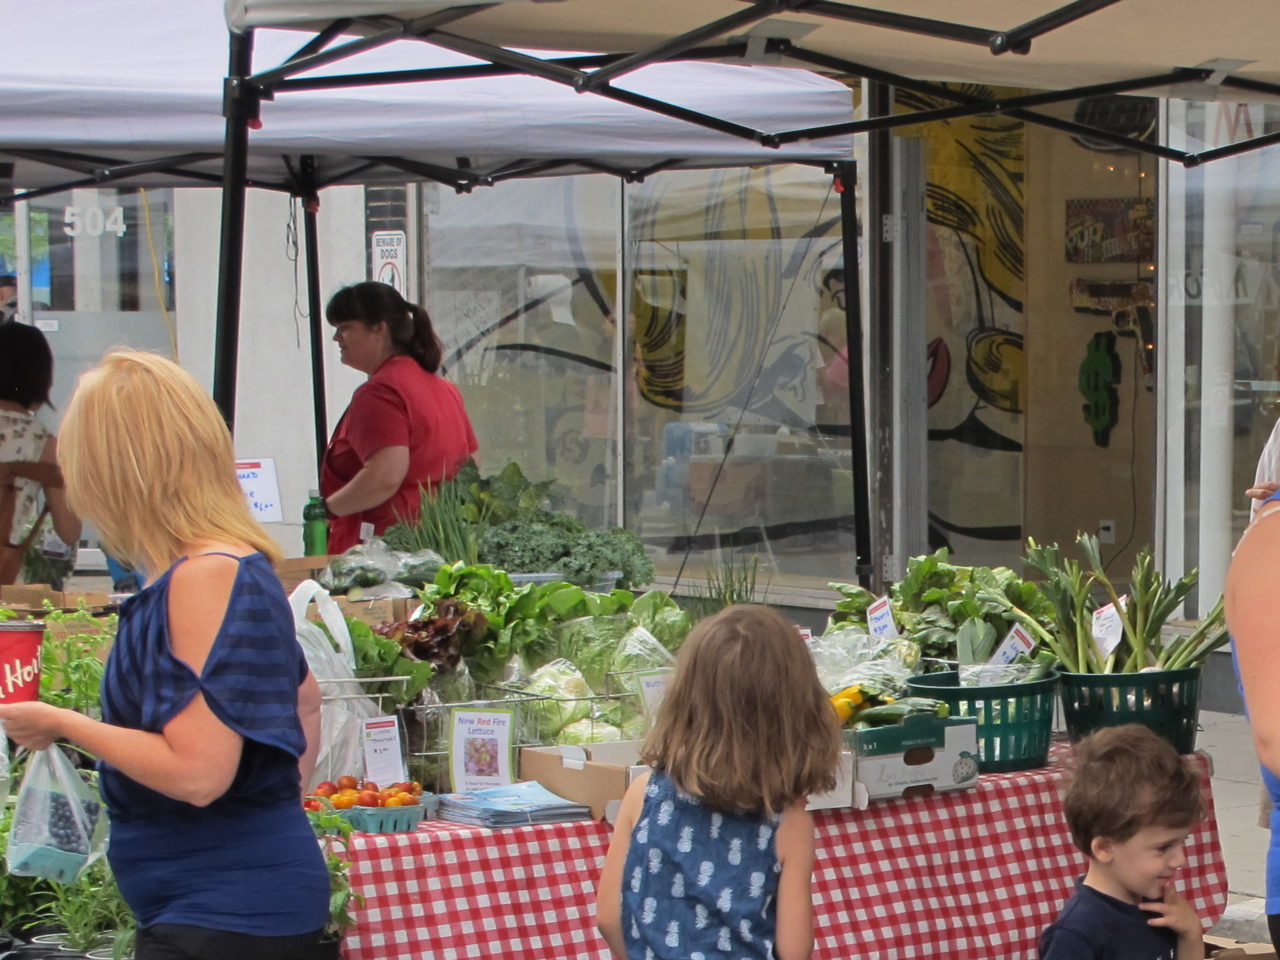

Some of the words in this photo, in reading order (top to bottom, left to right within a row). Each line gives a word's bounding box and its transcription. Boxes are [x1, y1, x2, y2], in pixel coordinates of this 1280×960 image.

[63, 206, 127, 237] 504
[376, 237, 394, 247] BEWARE
[395, 237, 403, 246] OF
[380, 249, 398, 260] DOGS
[458, 717, 475, 726] New
[476, 717, 491, 726] Red
[492, 717, 506, 727] Fire
[468, 727, 495, 736] Lettuce
